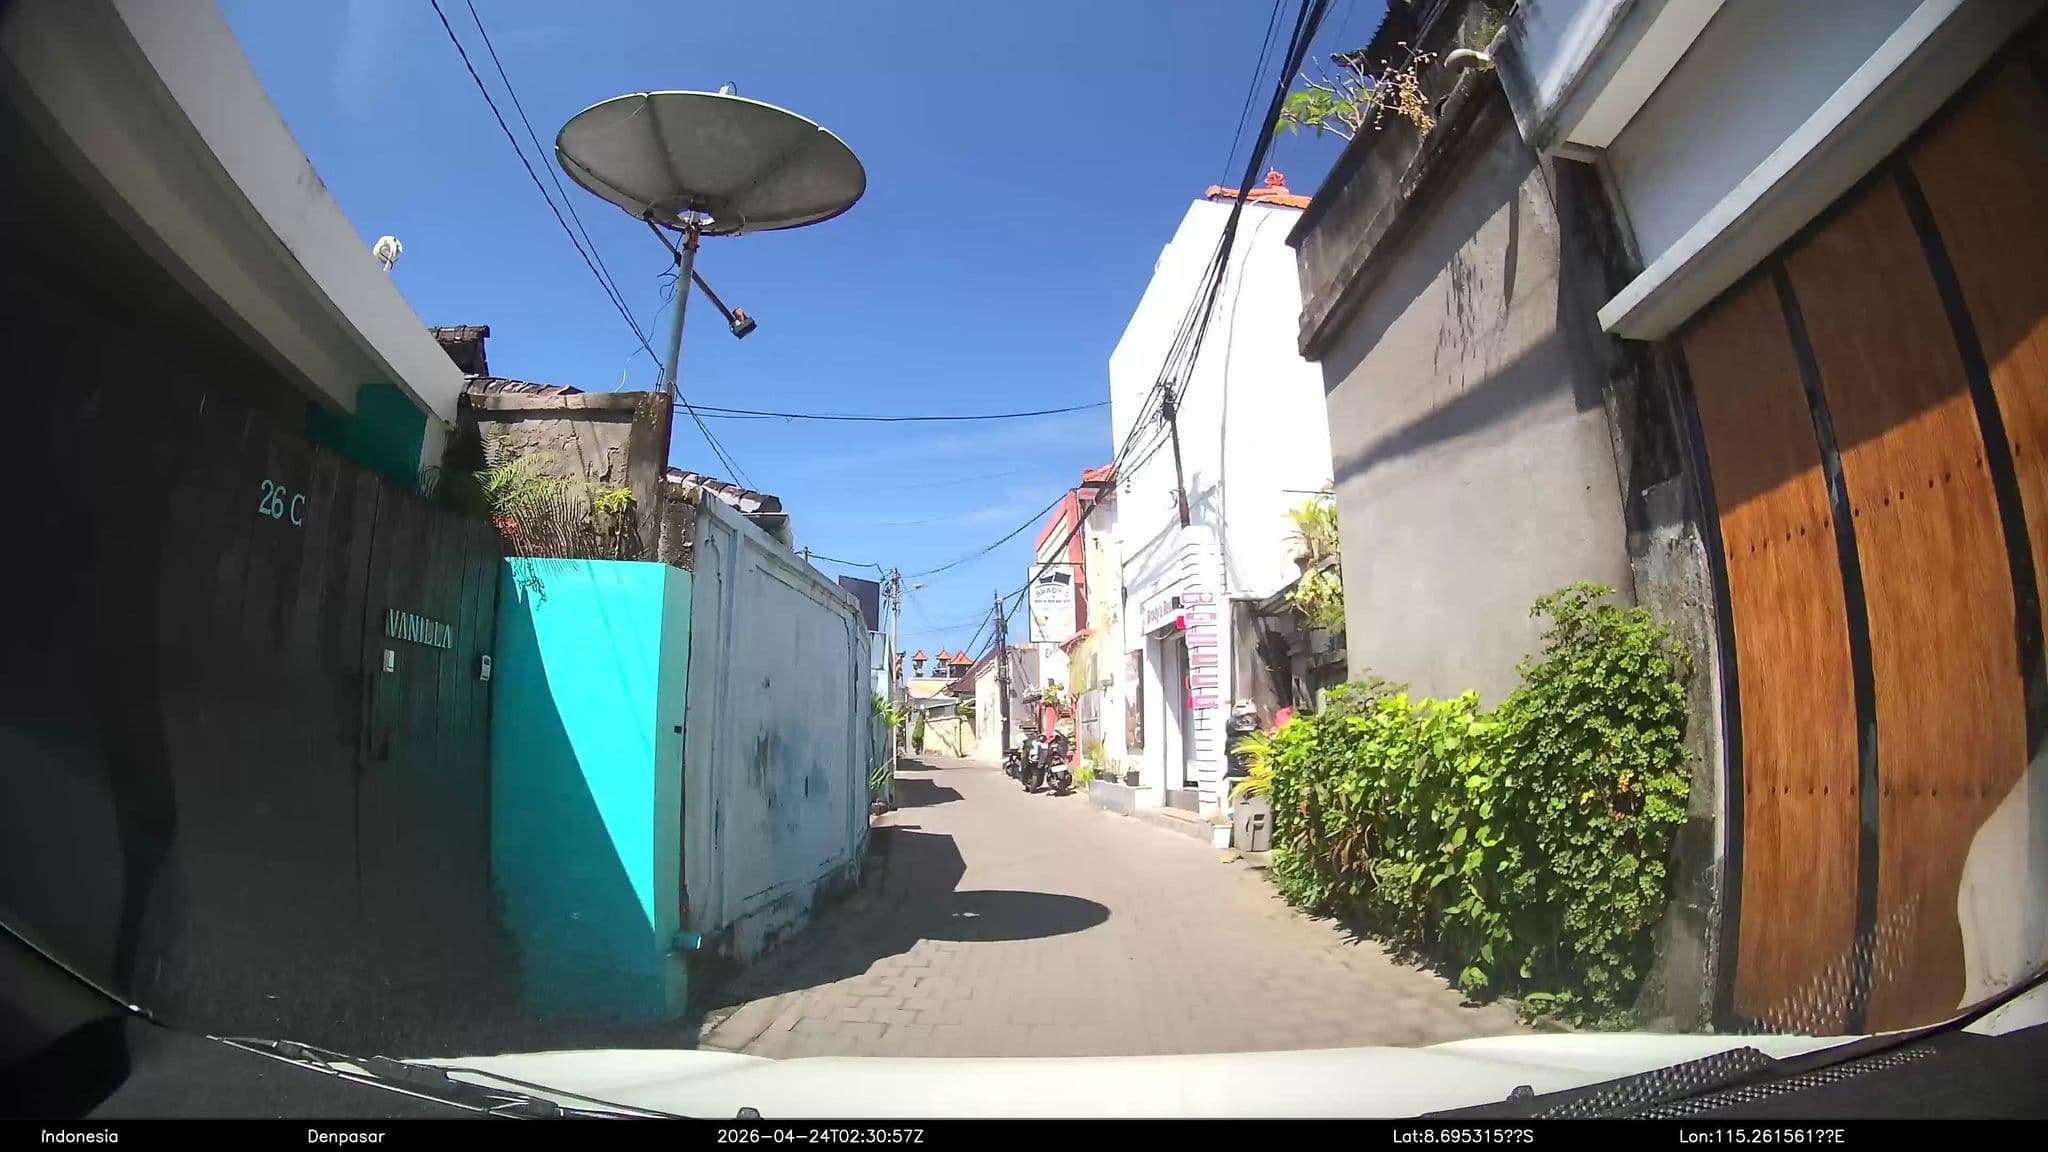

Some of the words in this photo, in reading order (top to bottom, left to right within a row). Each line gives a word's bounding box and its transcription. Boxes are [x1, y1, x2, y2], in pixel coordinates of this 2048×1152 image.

[259, 479, 287, 520] 26
[290, 493, 306, 527] C
[387, 608, 452, 649] VANILLA
